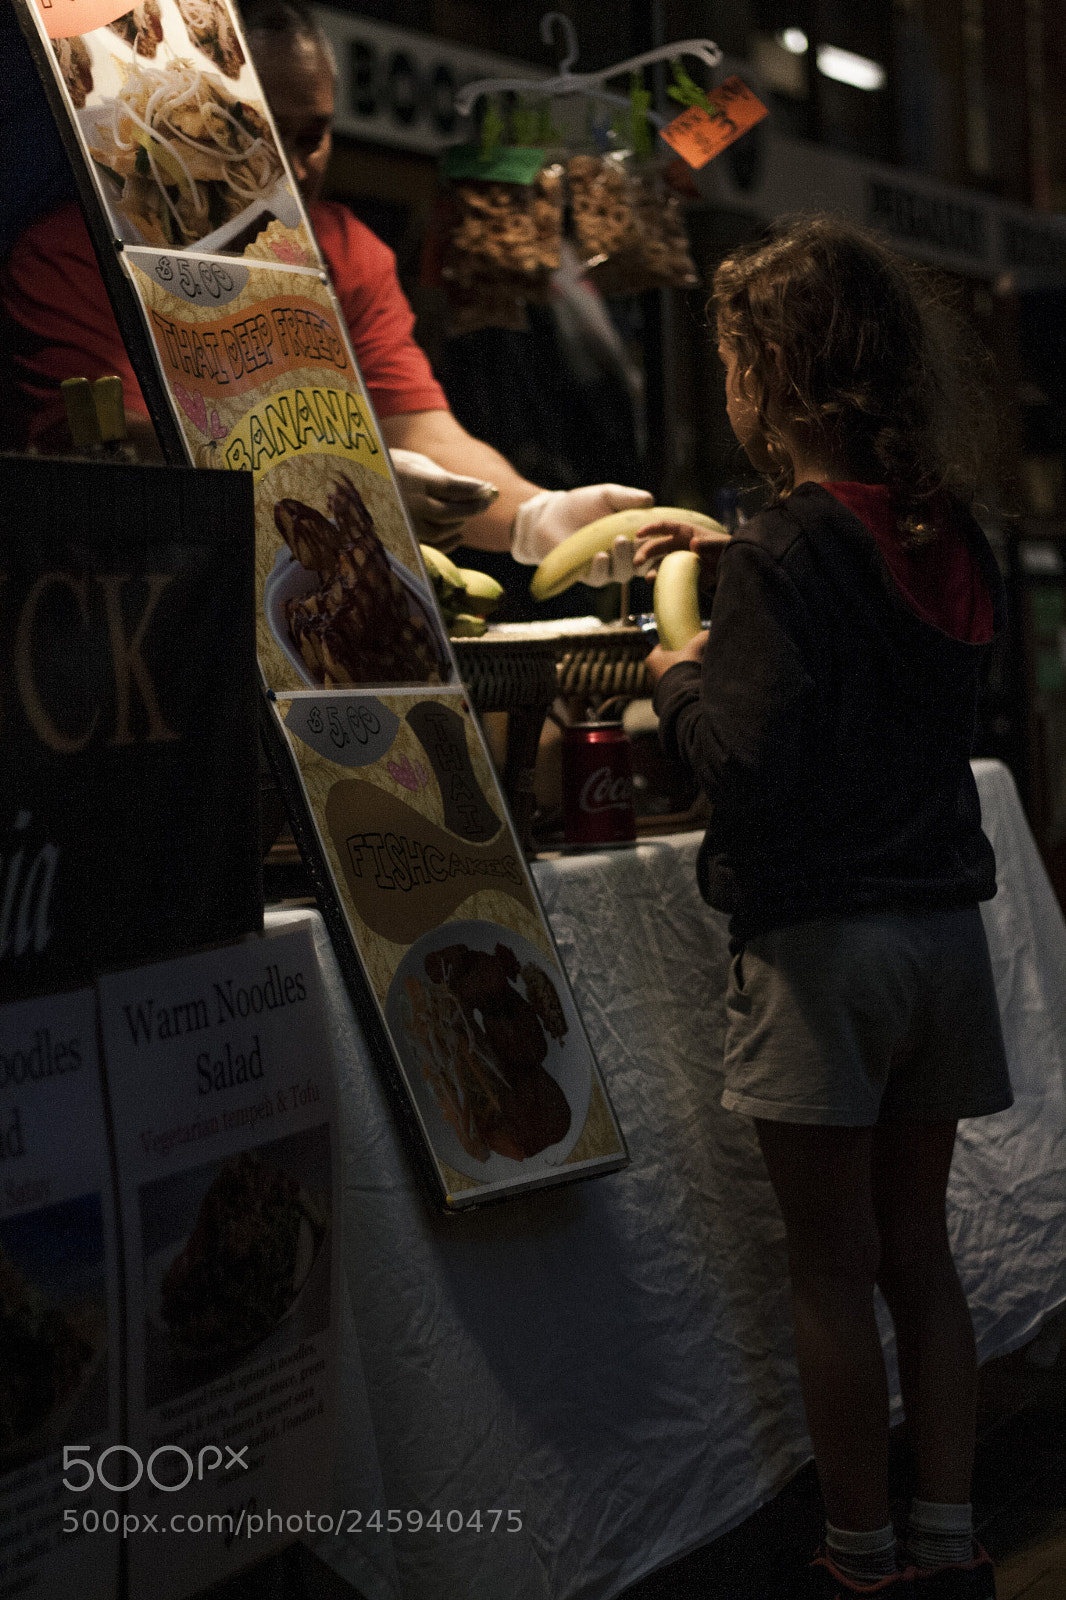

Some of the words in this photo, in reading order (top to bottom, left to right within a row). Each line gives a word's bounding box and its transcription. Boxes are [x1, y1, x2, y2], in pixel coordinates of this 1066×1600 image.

[154, 309, 229, 385] THAI
[221, 314, 273, 379] DEEP
[273, 307, 348, 370] FRIED
[226, 390, 378, 471] BANANA
[0, 569, 181, 753] CK
[306, 705, 382, 748] $5.00
[425, 712, 483, 835] THAI
[346, 832, 523, 892] FISHCAKES
[123, 997, 211, 1047] Warm
[213, 964, 308, 1025] Noodles
[196, 1035, 265, 1096] Salad
[277, 1090, 288, 1113] &
[289, 1078, 321, 1109] Tofu
